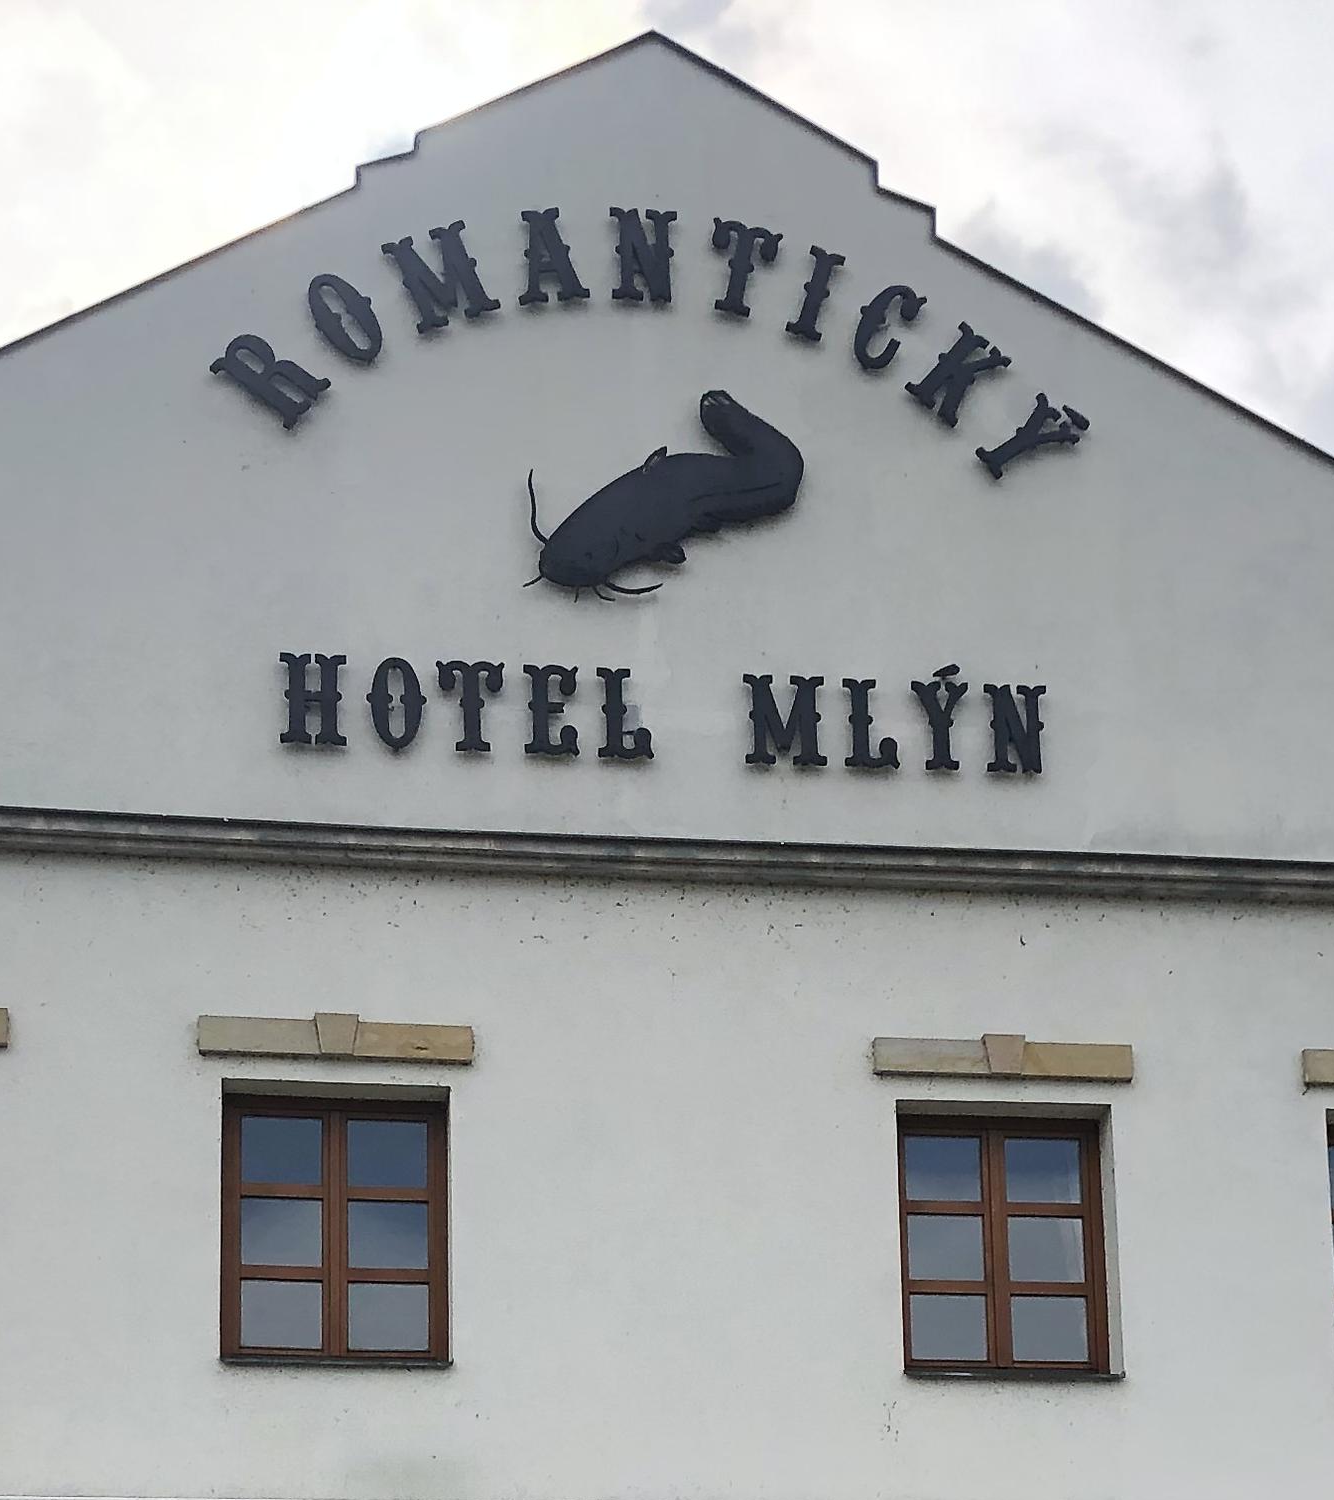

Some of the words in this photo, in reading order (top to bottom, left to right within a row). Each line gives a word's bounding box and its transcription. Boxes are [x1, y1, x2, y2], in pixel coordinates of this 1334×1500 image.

[209, 207, 1091, 480] ROMANTICKÝ
[279, 652, 655, 760] HOTEL
[742, 663, 1047, 775] MLÝN
